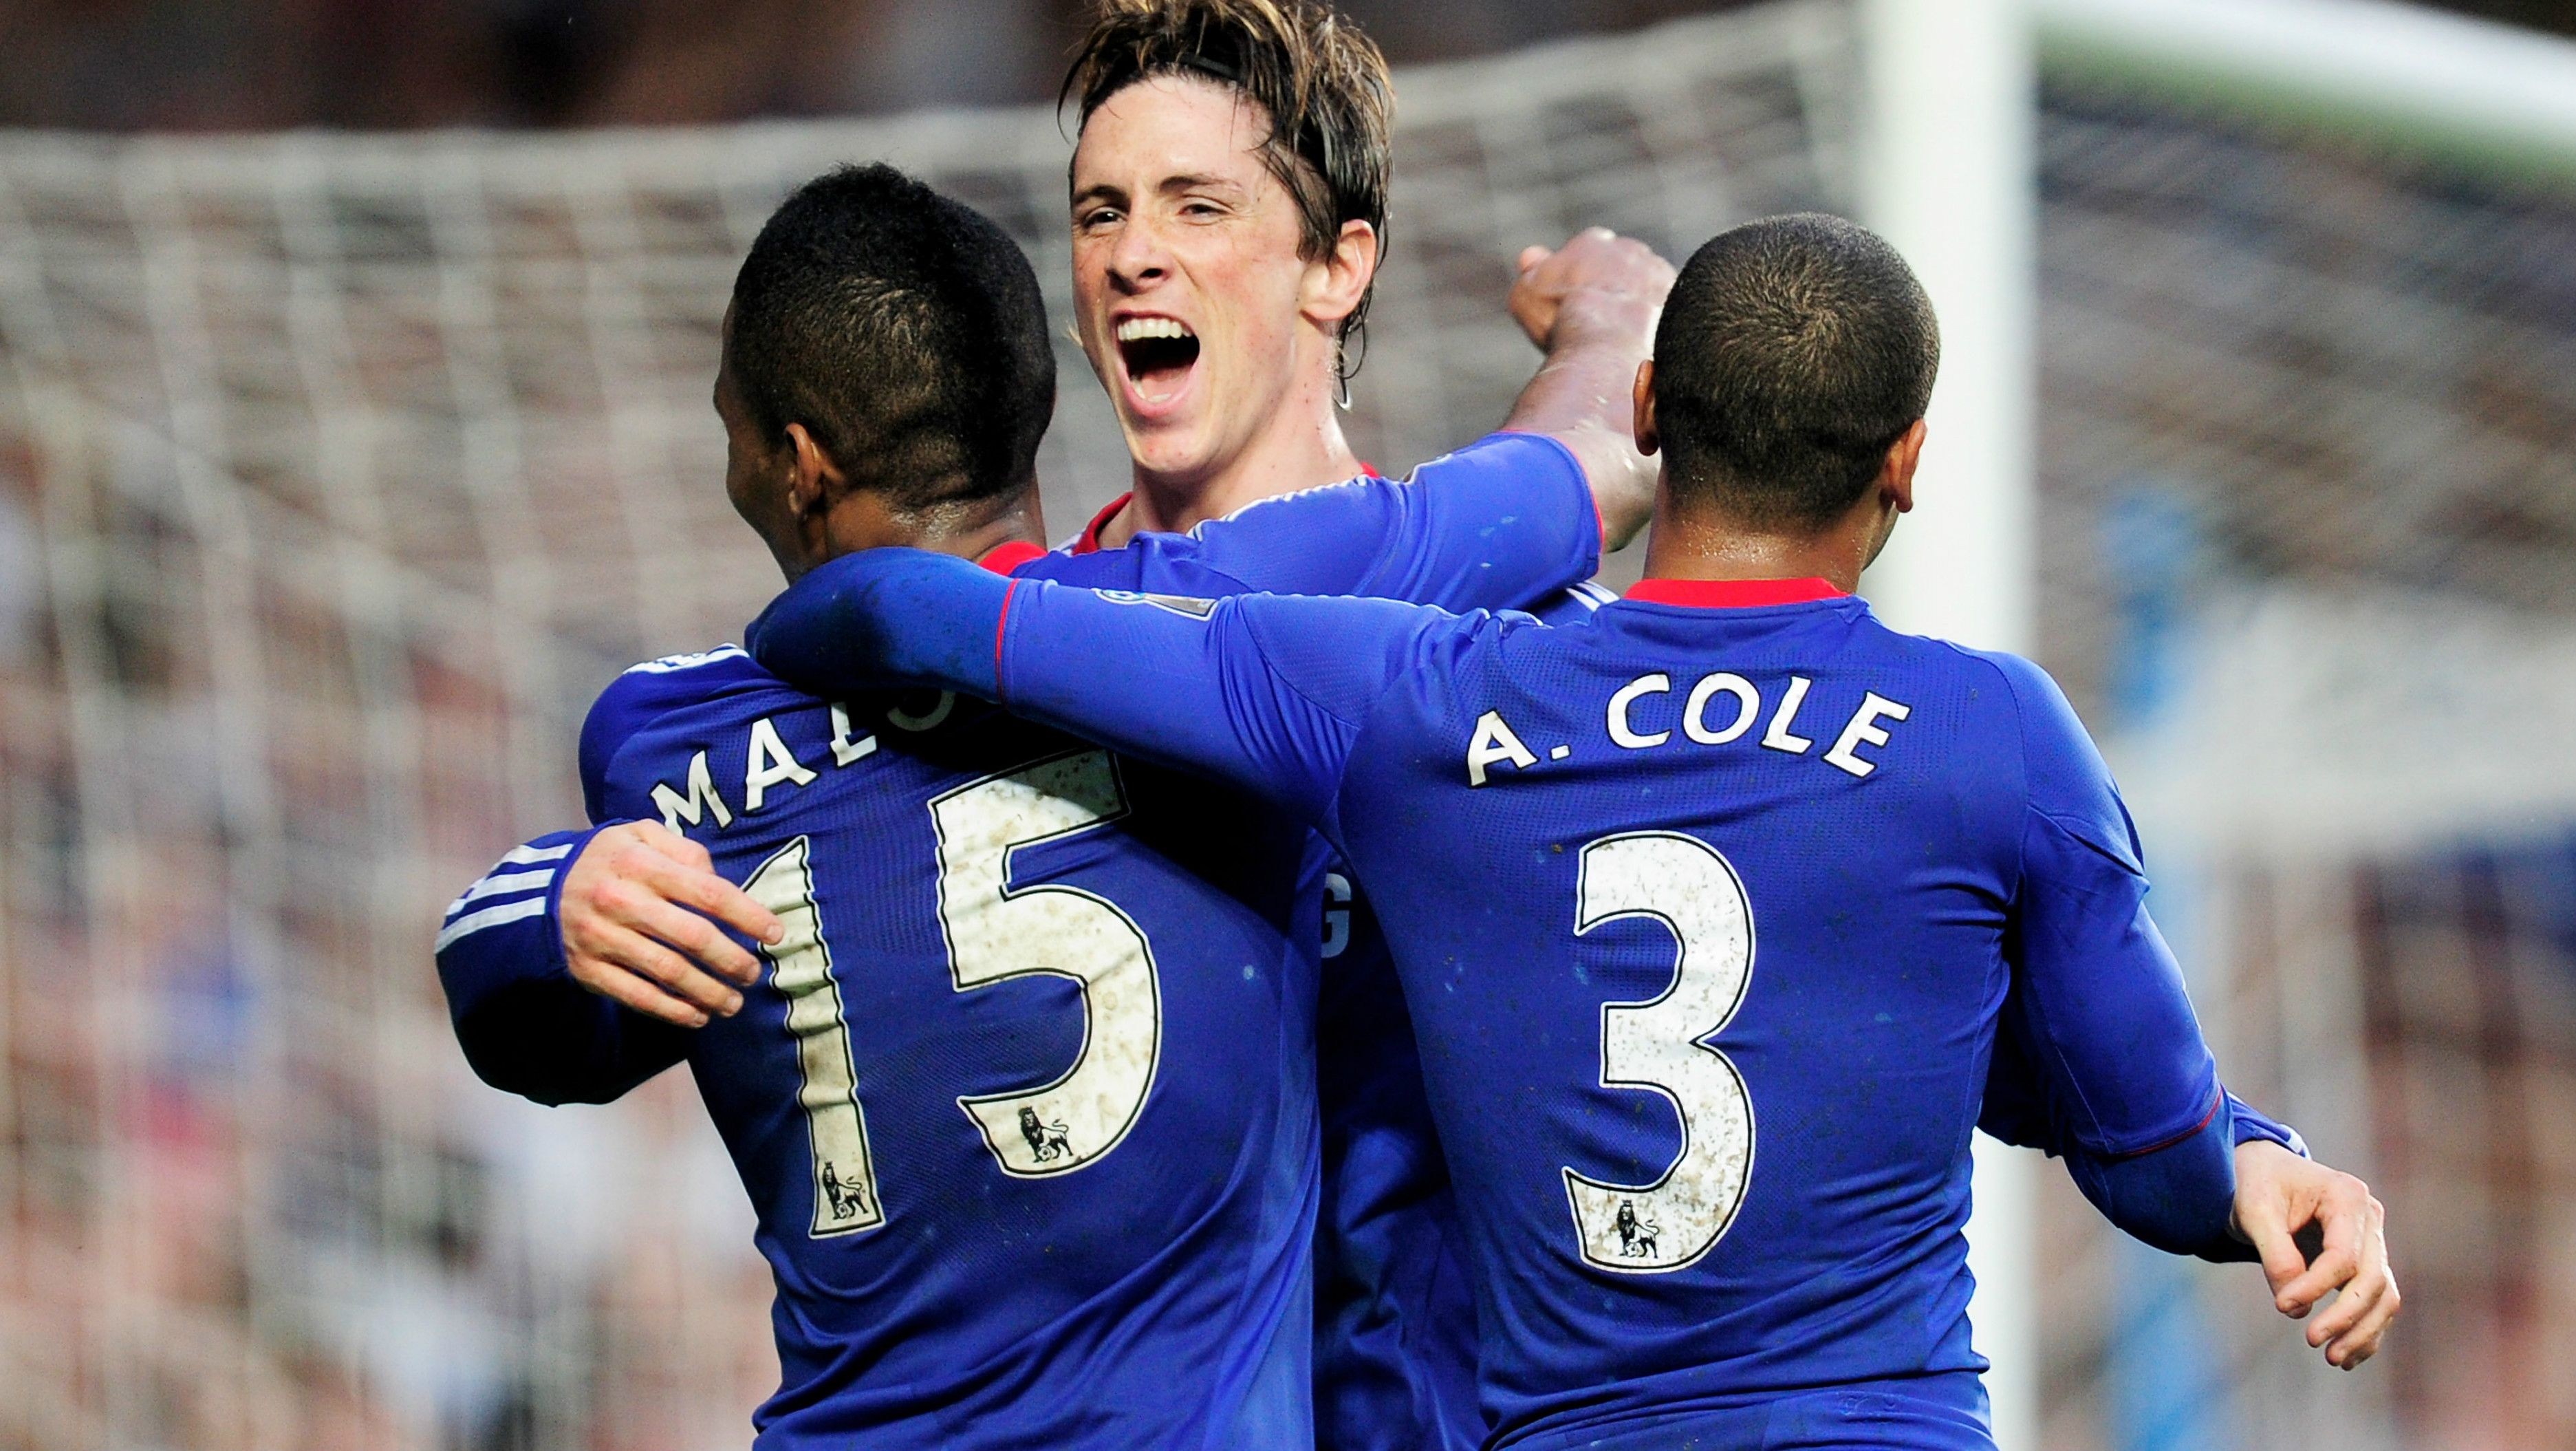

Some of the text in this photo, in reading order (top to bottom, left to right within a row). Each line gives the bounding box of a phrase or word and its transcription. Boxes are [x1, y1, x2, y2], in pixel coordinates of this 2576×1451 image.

[1466, 671, 1914, 788] A. COLE
[737, 746, 1162, 1240] 15
[1561, 830, 1756, 1273] 3
